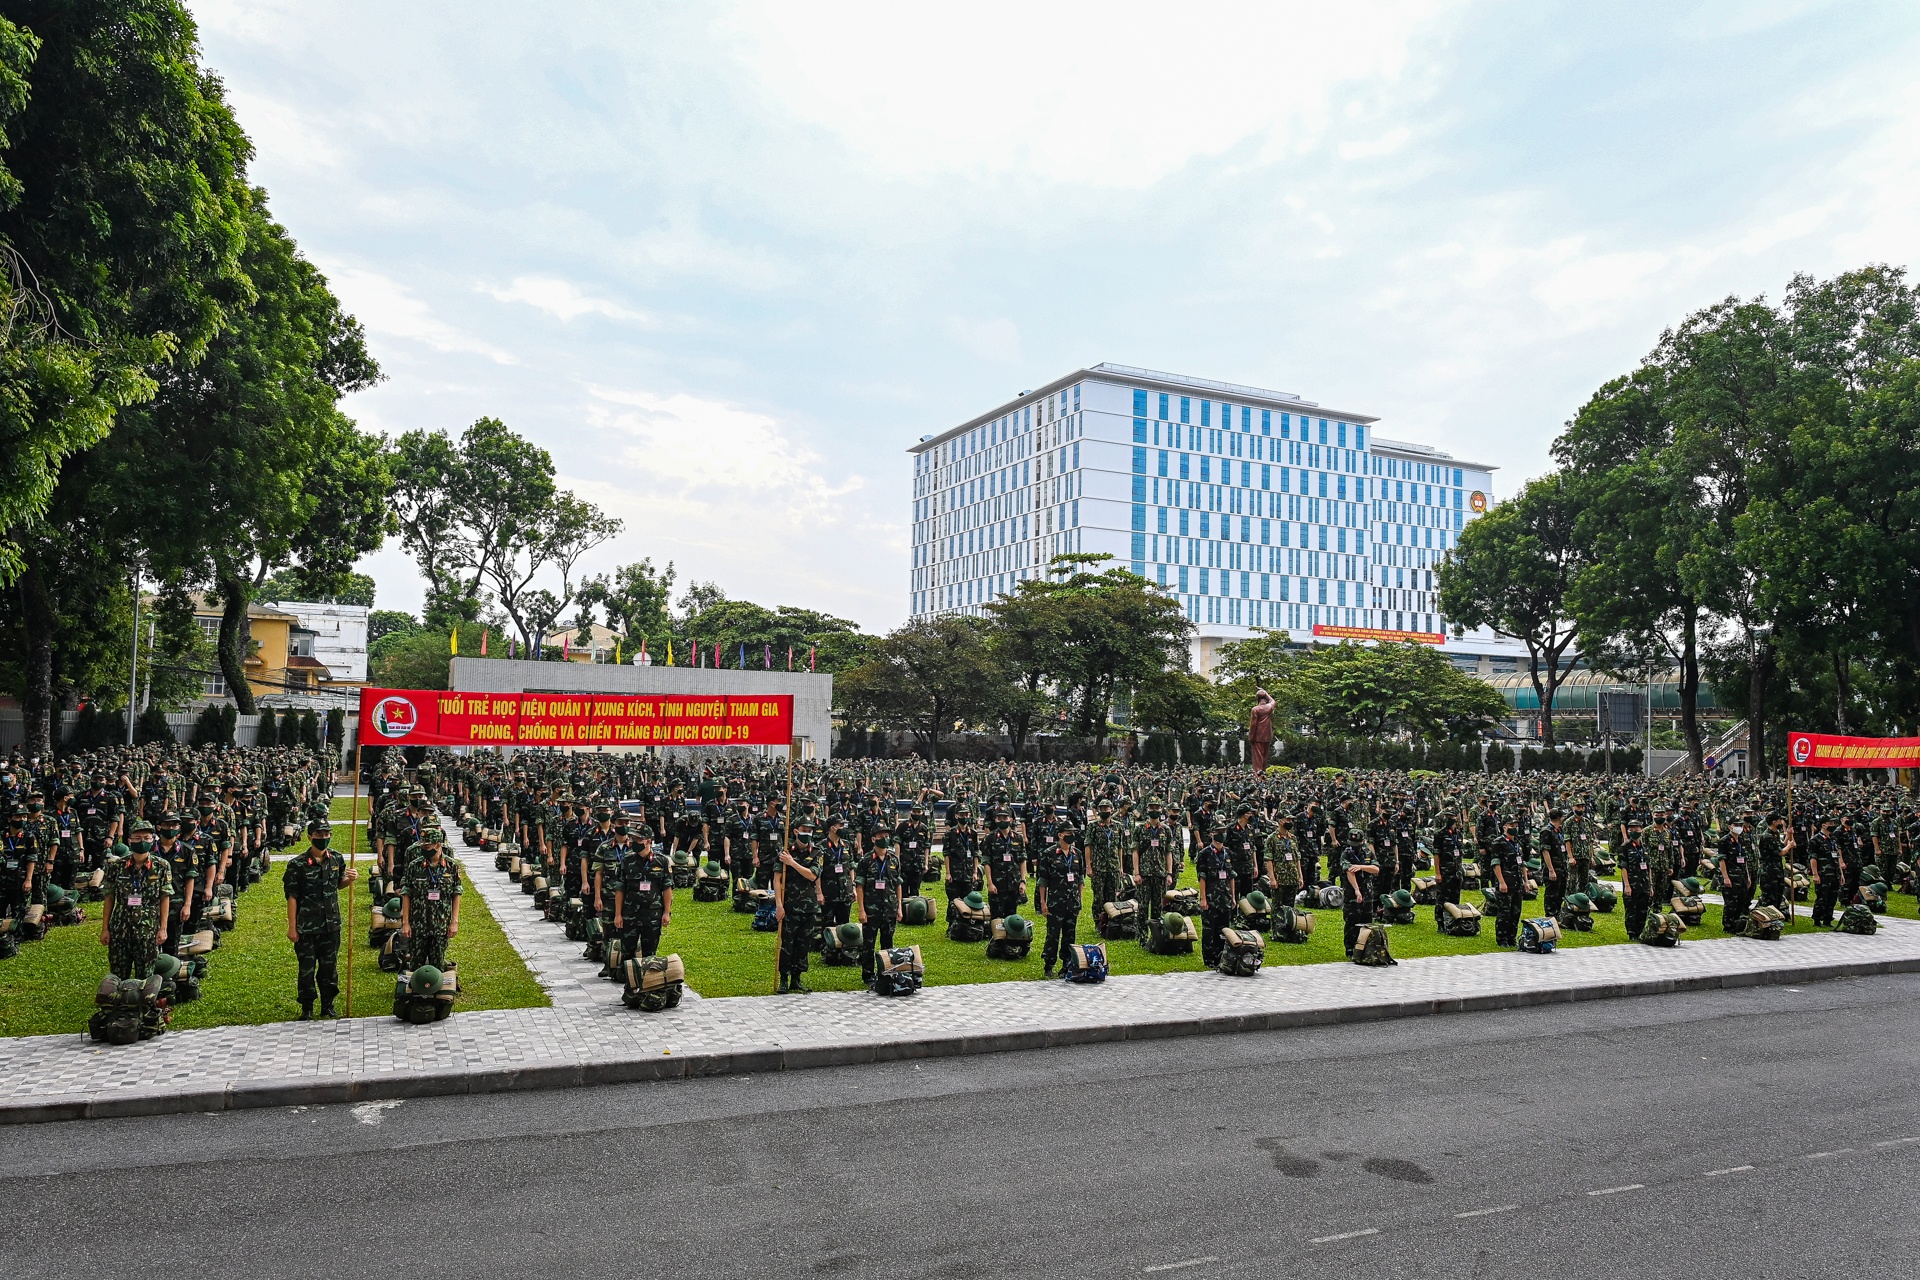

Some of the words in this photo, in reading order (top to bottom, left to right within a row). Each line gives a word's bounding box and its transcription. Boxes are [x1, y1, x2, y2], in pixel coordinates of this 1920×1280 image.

[437, 694, 465, 715] TUỔI
[467, 694, 489, 715] TRẺ
[492, 700, 517, 719] HỌC
[520, 698, 546, 719] VIỆN
[549, 699, 581, 718] QUÂN
[584, 702, 592, 717] Y
[593, 702, 624, 717] XUNG
[627, 700, 656, 719] KÍCH,
[659, 700, 683, 717] TÌNH
[685, 700, 727, 720] NGUYỆN
[730, 702, 759, 717] THAM
[761, 702, 779, 717] GIA
[470, 721, 514, 741] PHÒNG,
[518, 720, 557, 740] CHỐNG
[560, 722, 575, 740] VÀ
[577, 720, 612, 740] CHIẾN
[614, 720, 650, 740] THẮNG
[652, 725, 671, 742] ĐẠI
[673, 725, 699, 742] DỊCH
[701, 725, 749, 739] COVID-19
